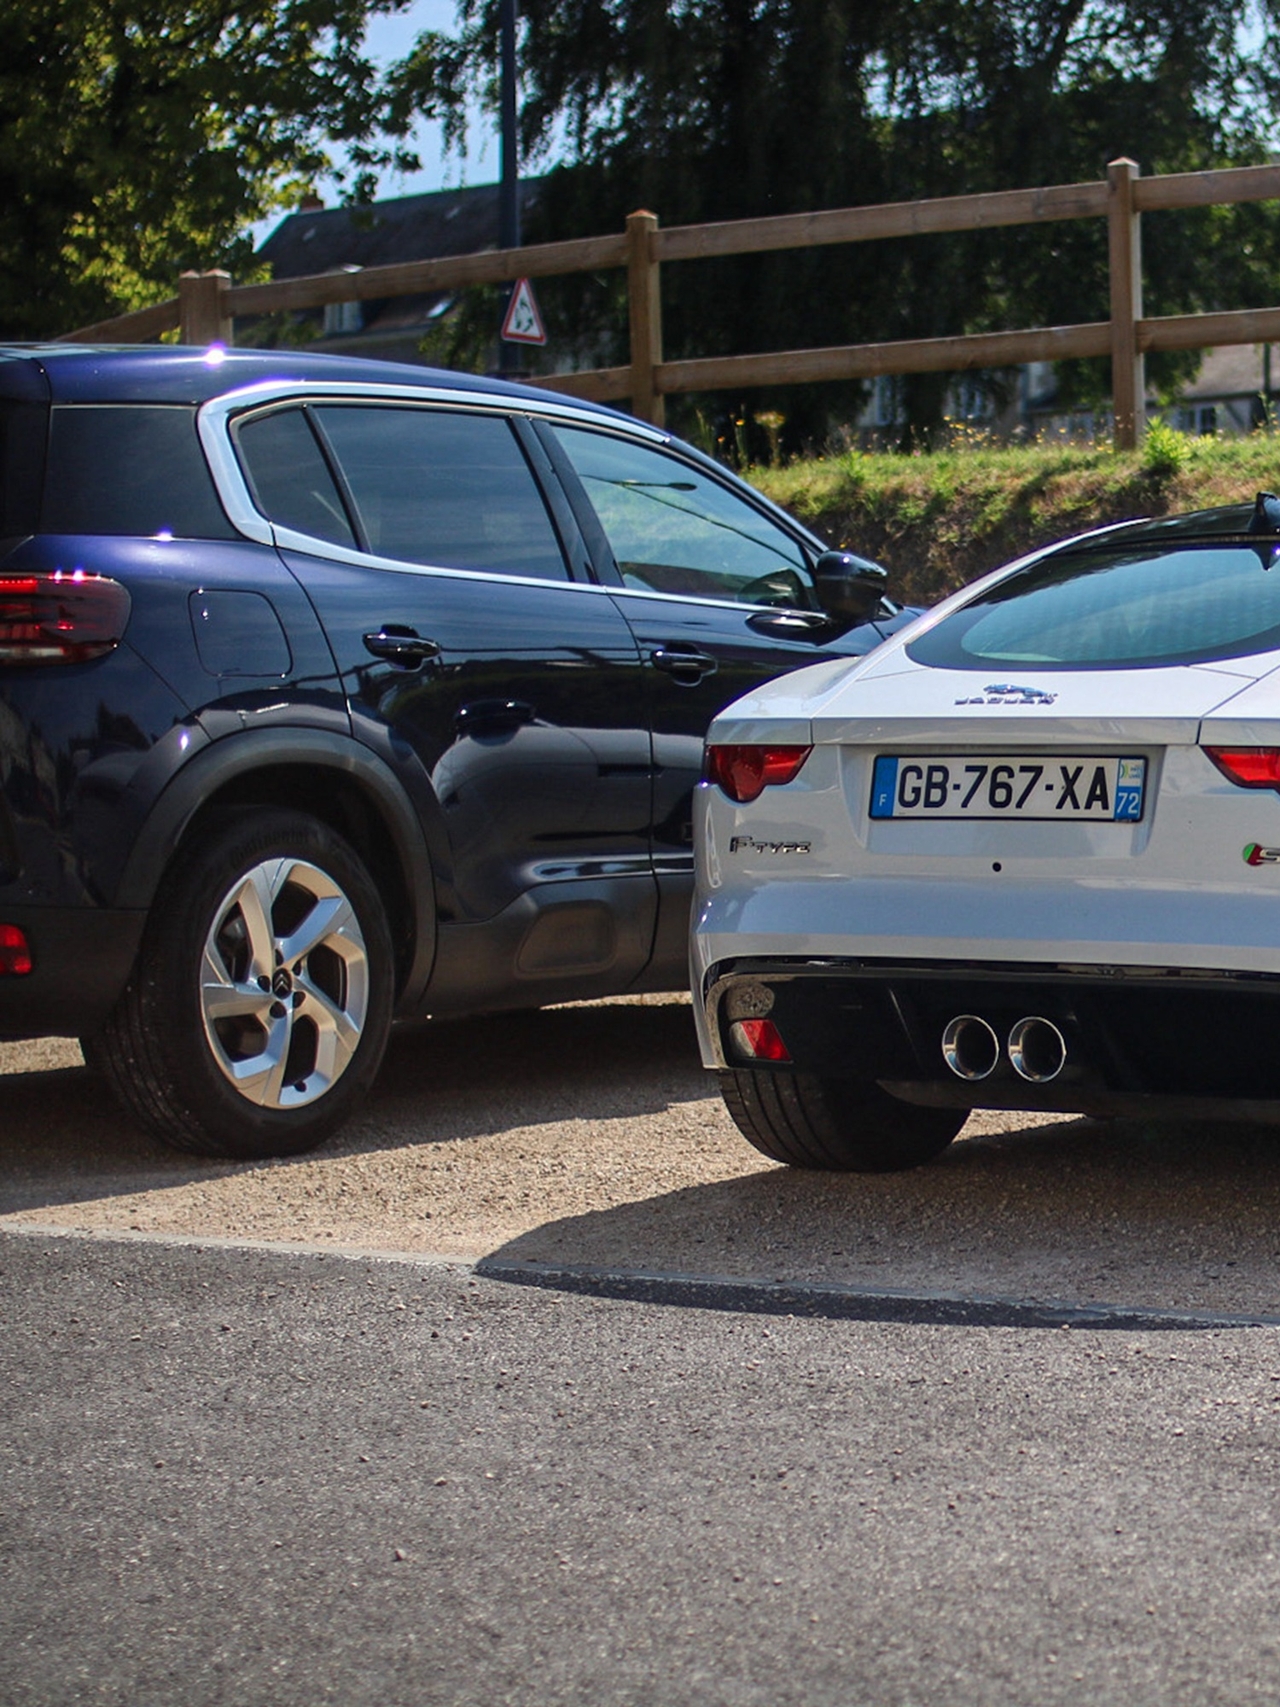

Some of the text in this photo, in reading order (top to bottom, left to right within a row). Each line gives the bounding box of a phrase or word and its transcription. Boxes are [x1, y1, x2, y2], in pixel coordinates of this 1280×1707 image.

[954, 697, 1055, 706] JAGUAR
[898, 765, 1110, 811] GB-767-XA
[879, 794, 887, 807] F
[1116, 792, 1139, 814] 72
[729, 835, 812, 853] F-TYPE
